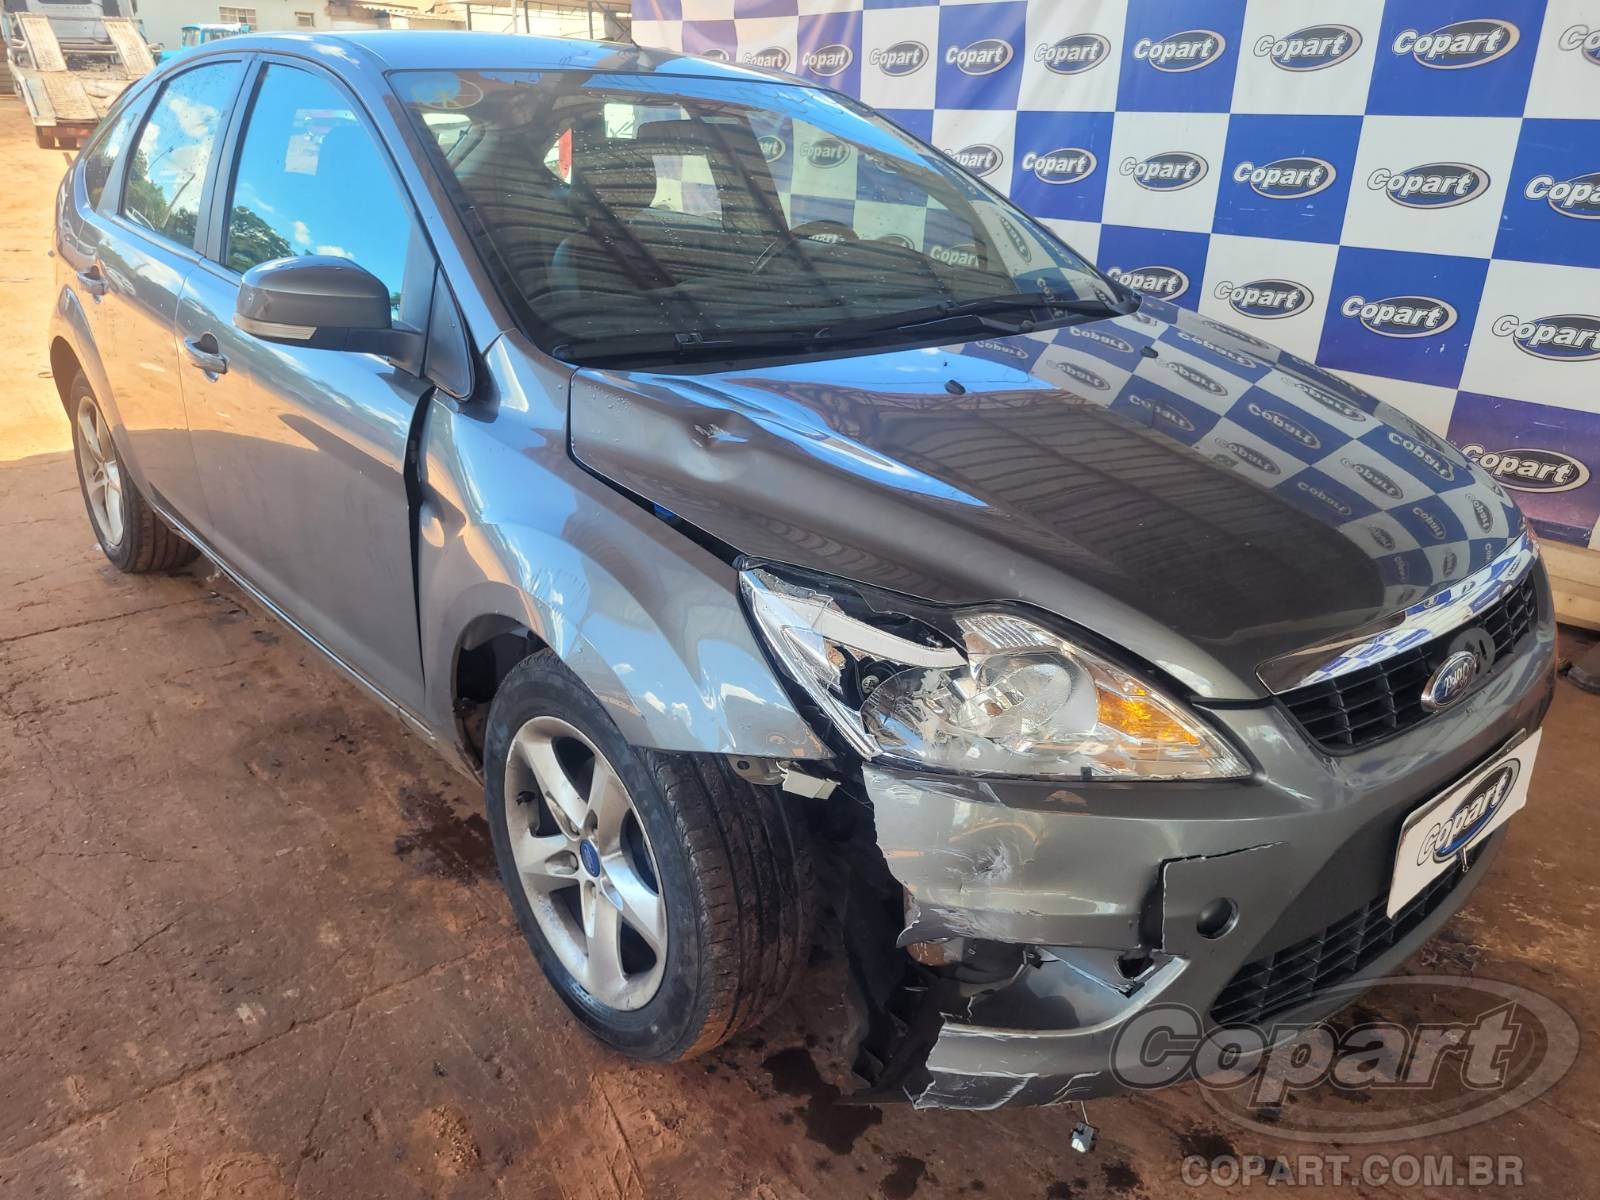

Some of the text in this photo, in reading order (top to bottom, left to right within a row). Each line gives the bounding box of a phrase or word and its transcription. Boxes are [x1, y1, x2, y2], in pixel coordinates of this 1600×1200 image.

[945, 45, 1003, 66] Copart
[1034, 41, 1098, 64] Copart
[1133, 36, 1213, 64] Copart
[1253, 31, 1350, 63] Copart
[1393, 26, 1504, 60] Copart
[802, 50, 846, 69] Copart
[869, 48, 921, 69] Copart
[1022, 152, 1088, 177] Copart
[1119, 156, 1199, 184] Copart
[1233, 161, 1324, 191] Copart
[1367, 168, 1474, 196] Copart
[1214, 281, 1300, 309] Copart
[1341, 295, 1443, 329] Copart
[1460, 444, 1573, 485] Copart
[1417, 767, 1509, 866] Copart
